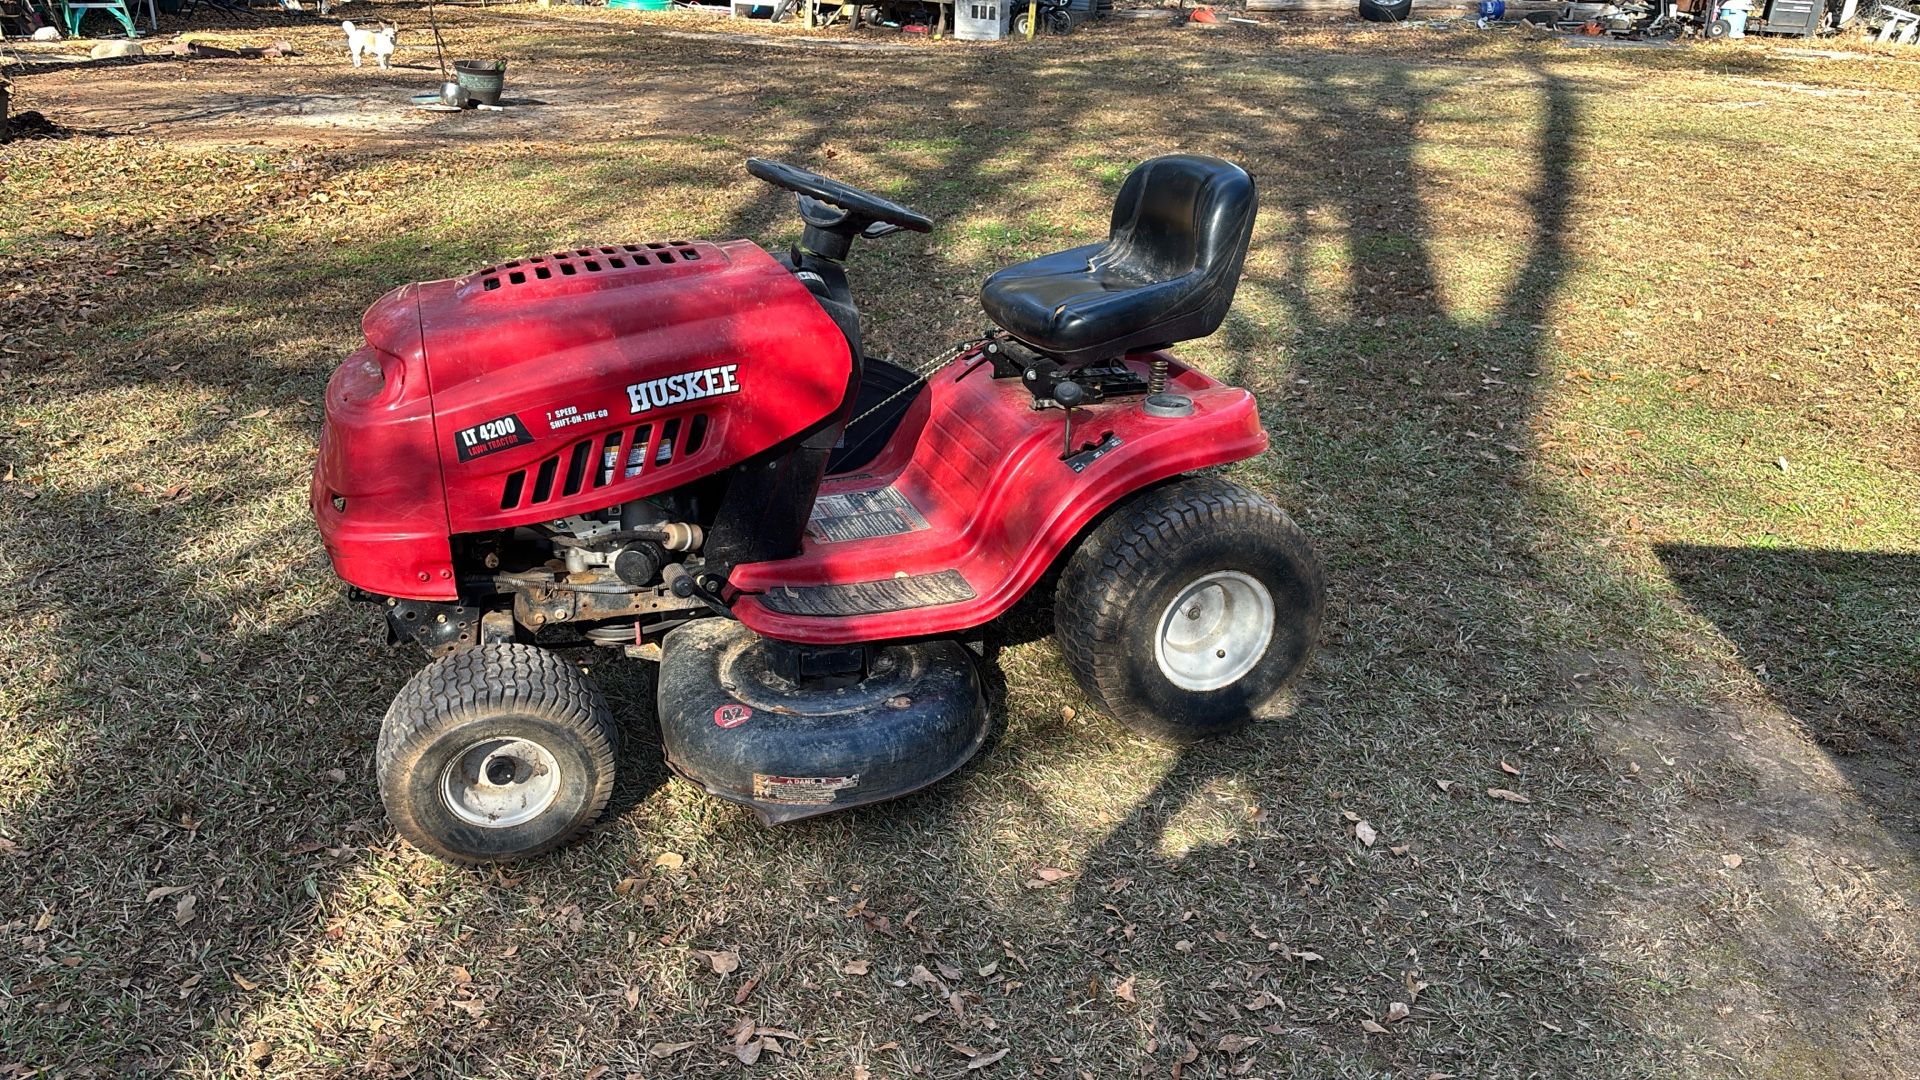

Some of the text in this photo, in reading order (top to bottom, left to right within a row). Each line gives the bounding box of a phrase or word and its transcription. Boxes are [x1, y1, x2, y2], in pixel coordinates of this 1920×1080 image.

[626, 364, 740, 414] HUSKEE
[549, 409, 608, 430] SHIFT-ON-THE-GO
[554, 406, 578, 418] SPEED
[461, 417, 516, 447] LT 4200
[467, 435, 519, 457] LAWN TRACTOR
[721, 706, 744, 722] 42
